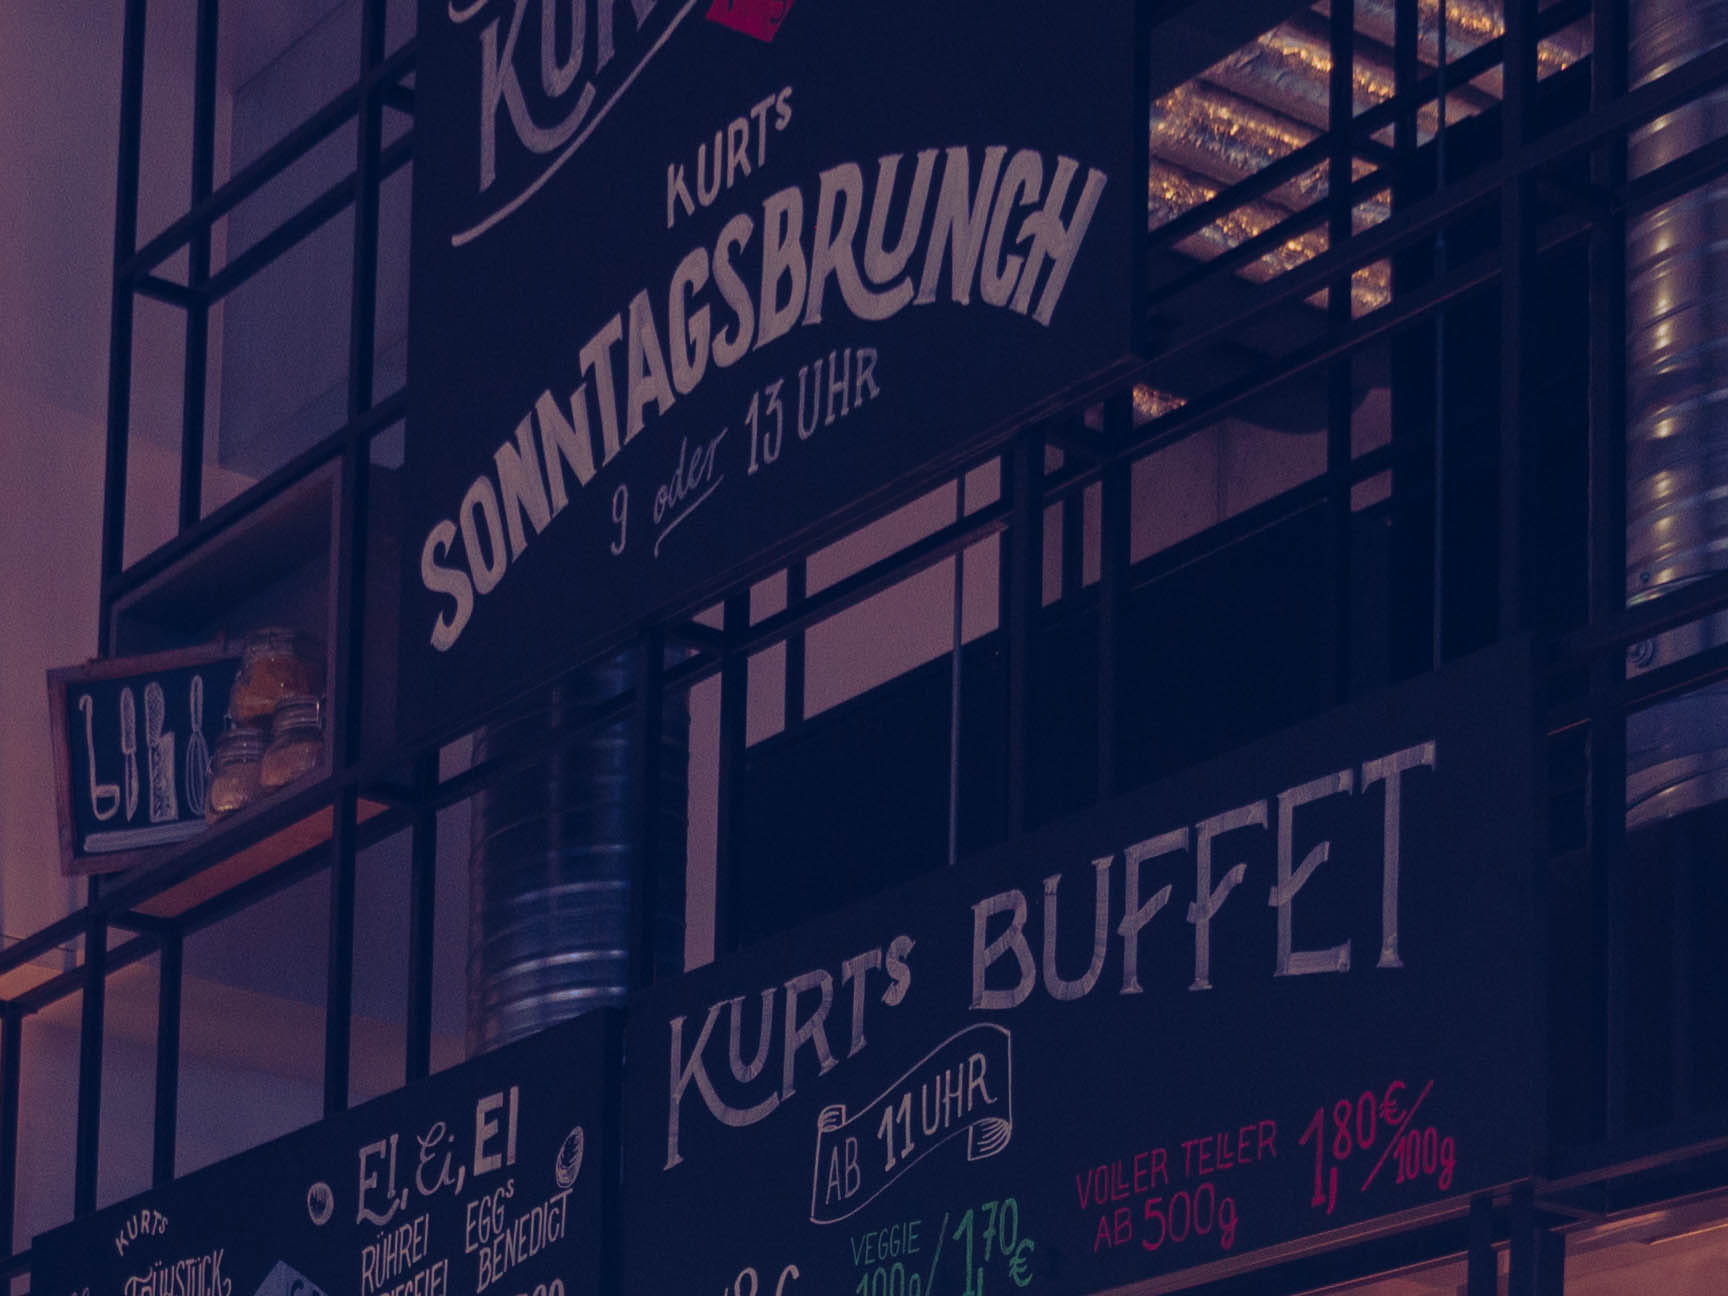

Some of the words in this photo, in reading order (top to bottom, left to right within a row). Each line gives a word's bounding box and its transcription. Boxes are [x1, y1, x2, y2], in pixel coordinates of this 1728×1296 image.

[420, 144, 1108, 653] SONNTAGSBRUNCH
[610, 484, 630, 556] 9
[653, 430, 729, 514] oder
[745, 378, 786, 477] 13
[797, 347, 881, 443] UHR
[969, 739, 1437, 1011] BUFFET
[473, 1085, 520, 1177] EI
[825, 1134, 862, 1206] AB
[877, 1093, 917, 1173] 11
[919, 1051, 997, 1151] UHR
[1075, 1148, 1169, 1211] VOLLER
[1181, 1119, 1277, 1179] TELLER
[476, 1188, 574, 1295] BENEDICT
[849, 1220, 922, 1267] VEGGIE
[1094, 1212, 1135, 1253] AB
[1141, 1181, 1240, 1253] 500g
